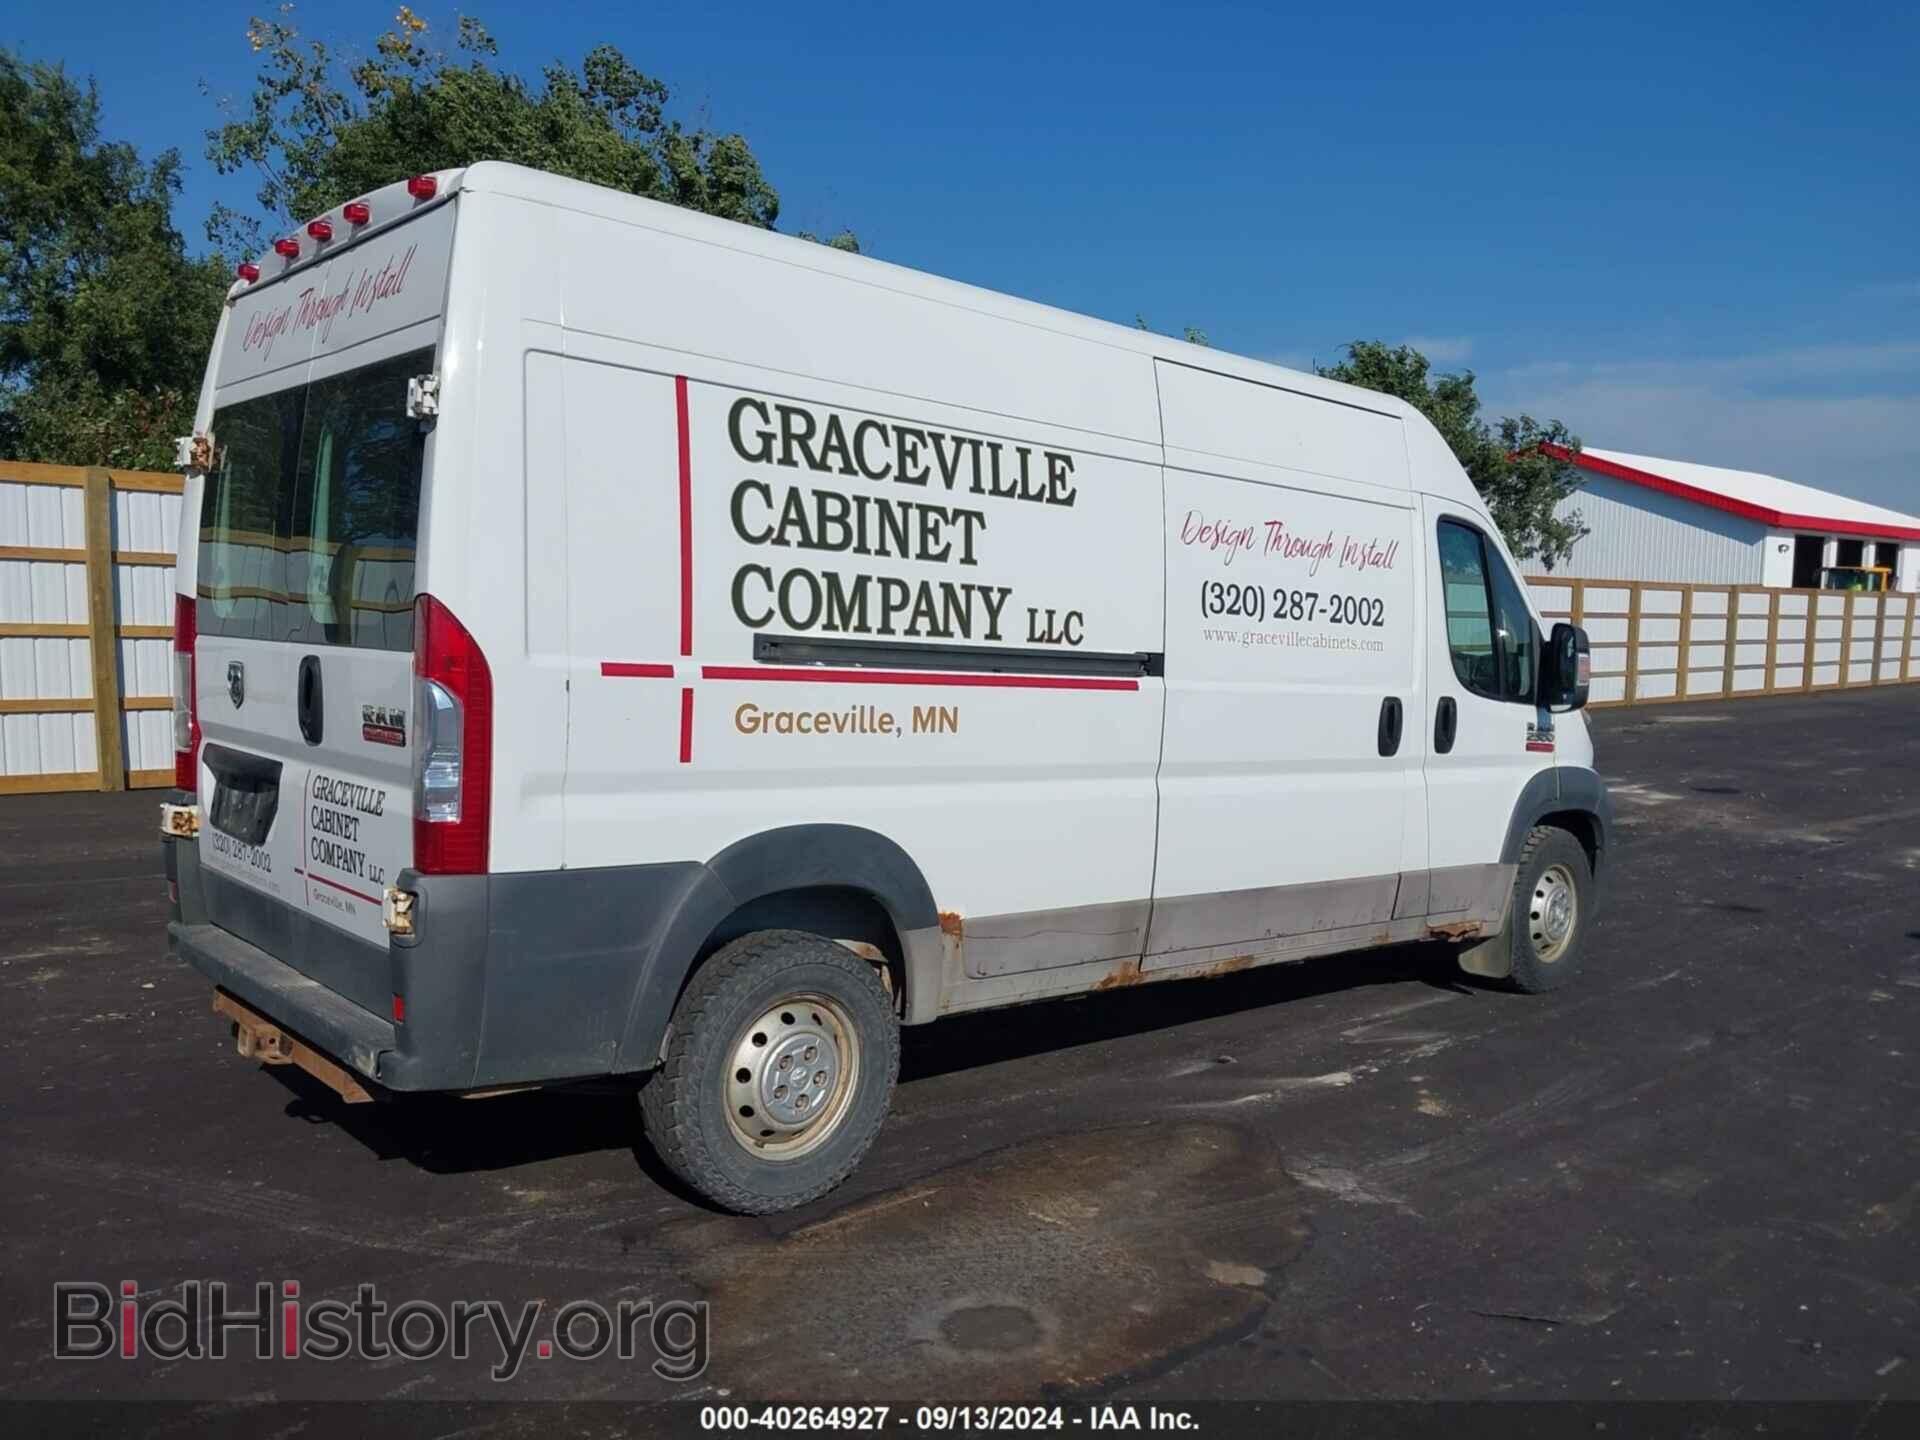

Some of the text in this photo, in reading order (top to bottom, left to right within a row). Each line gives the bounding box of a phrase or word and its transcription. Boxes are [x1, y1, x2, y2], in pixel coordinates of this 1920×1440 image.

[243, 243, 418, 361] Design Through Install
[728, 397, 1077, 506] GRACEVILLE
[730, 479, 987, 566] CABINET
[1181, 510, 1399, 577] Design Through Install
[731, 563, 1084, 646] COMPANY LLC
[1201, 580, 1384, 627] (320) 287-2002
[1203, 628, 1384, 652] www.gracevillecabinets.com
[735, 702, 959, 738] Graceville, MN
[312, 775, 386, 817] GRACEVILLE
[311, 805, 360, 842] CABINET
[311, 836, 366, 878] COMPANY
[369, 864, 385, 886] LLC
